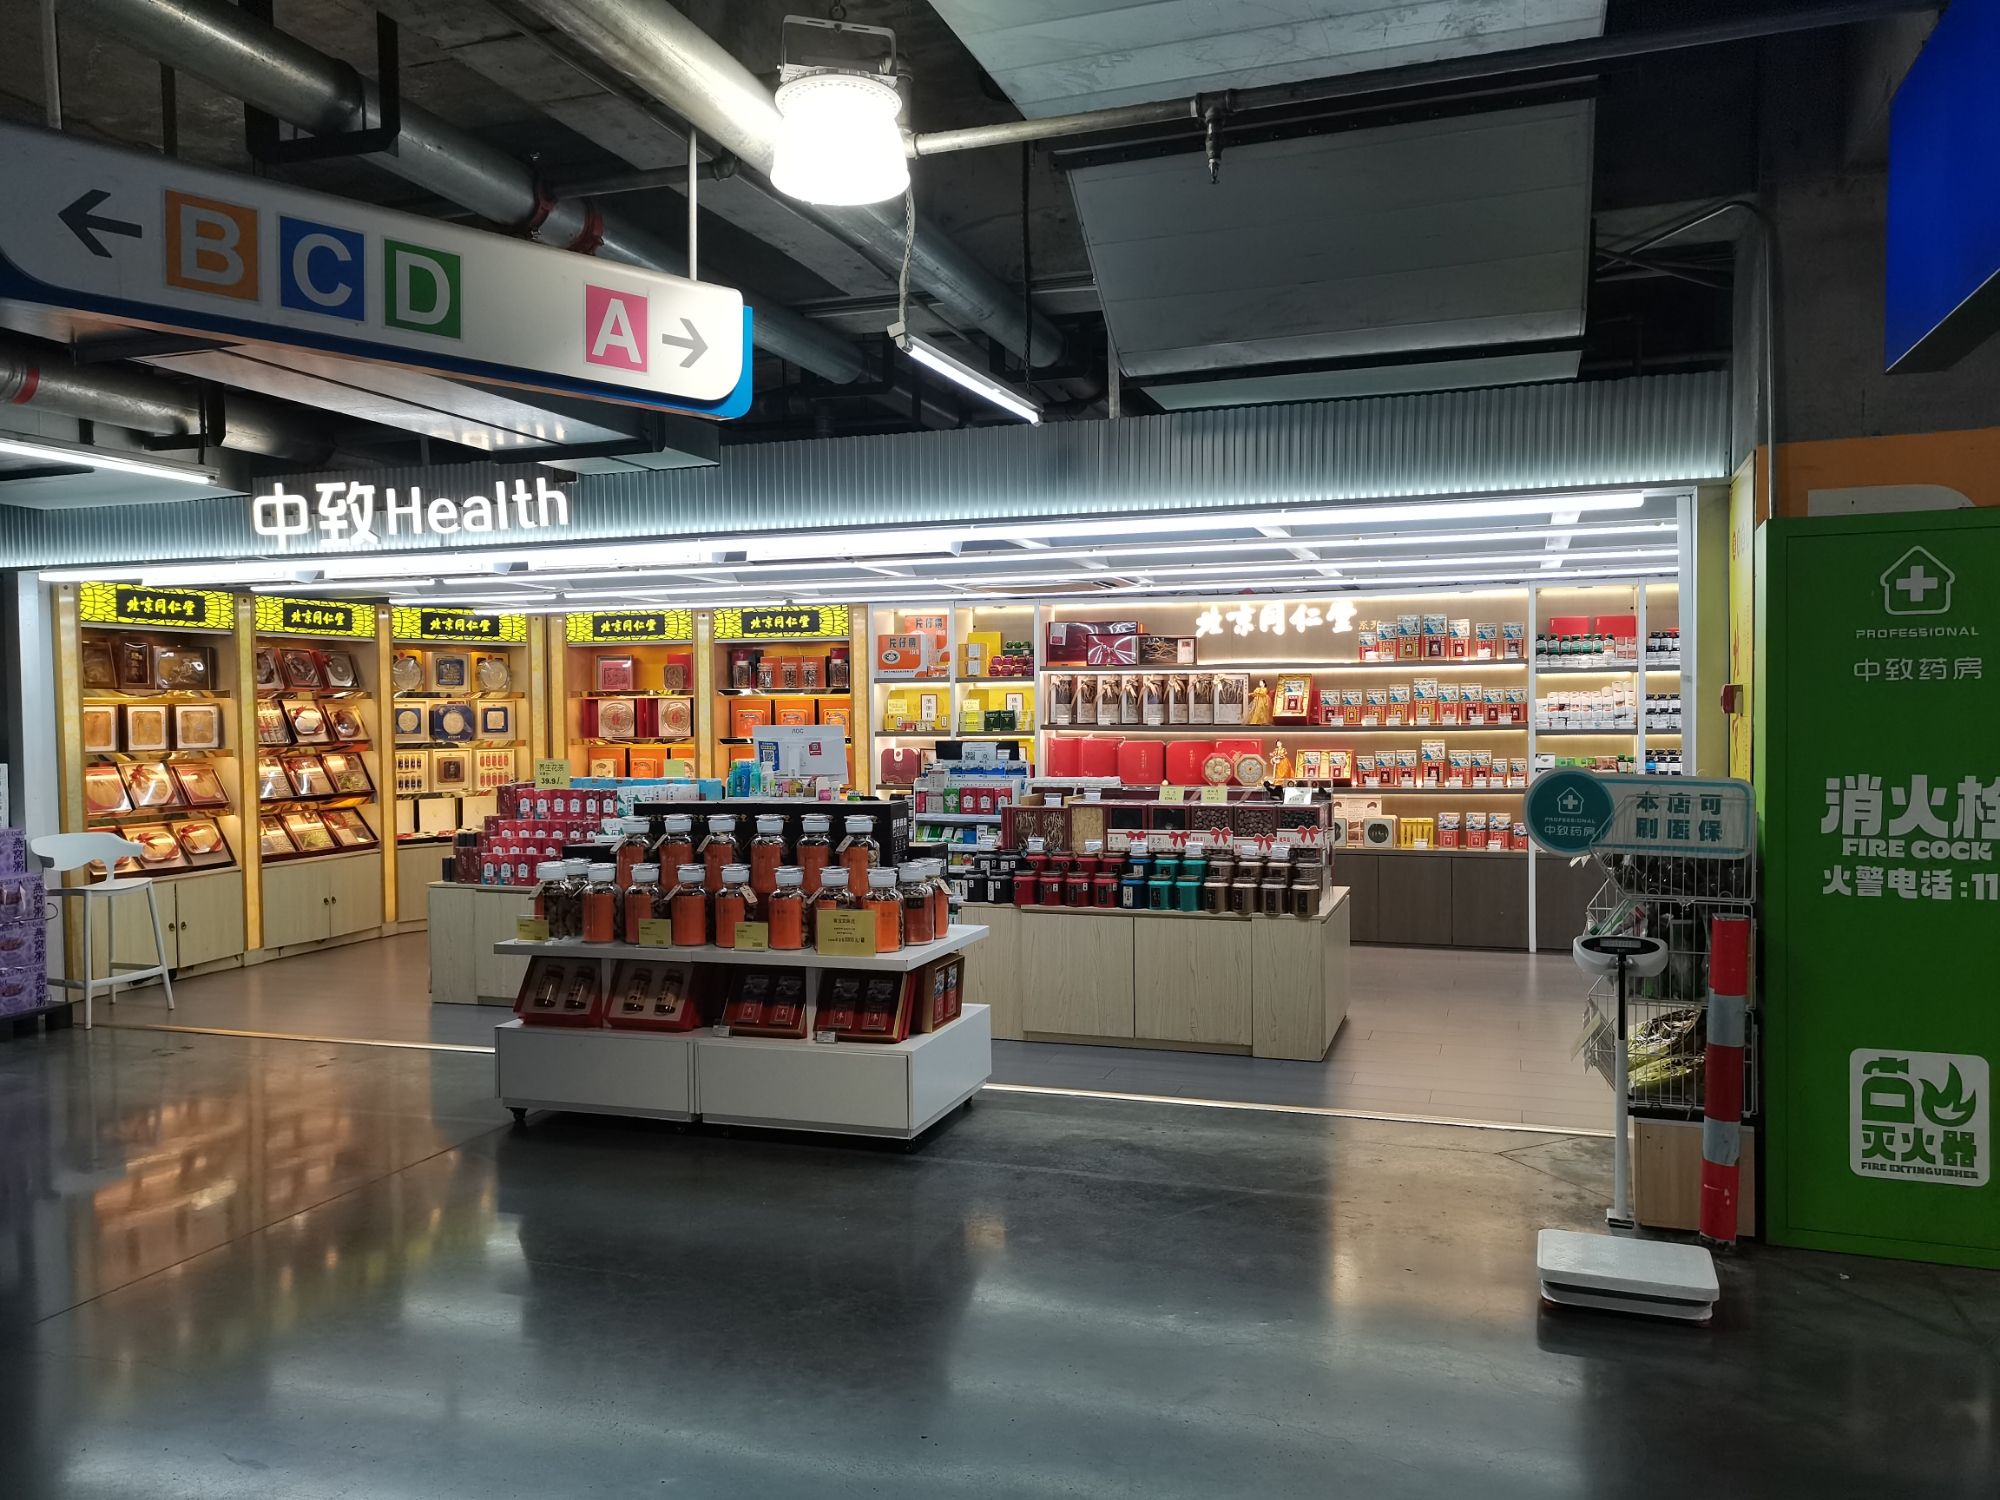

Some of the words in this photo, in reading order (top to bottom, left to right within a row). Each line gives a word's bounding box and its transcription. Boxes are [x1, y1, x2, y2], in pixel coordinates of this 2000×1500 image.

[180, 204, 245, 285] B
[291, 233, 352, 307] C
[395, 249, 451, 326] D
[591, 298, 642, 364] A
[253, 481, 382, 551] 中致
[386, 477, 568, 536] Health
[126, 596, 195, 616] 北京同仁堂
[291, 609, 345, 626] 北京同仁堂
[430, 618, 490, 634] 北京同仁堂
[600, 618, 657, 633] 北京同仁堂
[750, 615, 810, 631] 北京同仁堂
[1196, 600, 1357, 637] 北京同仁堂
[1856, 626, 1979, 639] PROFESSIONAL
[1853, 657, 1982, 682] 中致药房
[1842, 838, 1905, 858] FIRE
[1911, 840, 1992, 861] COCK
[1862, 1124, 1977, 1168] 灭火器
[1861, 1161, 1887, 1172] FIRE
[1889, 1164, 1979, 1179] EXTINGUISHER
